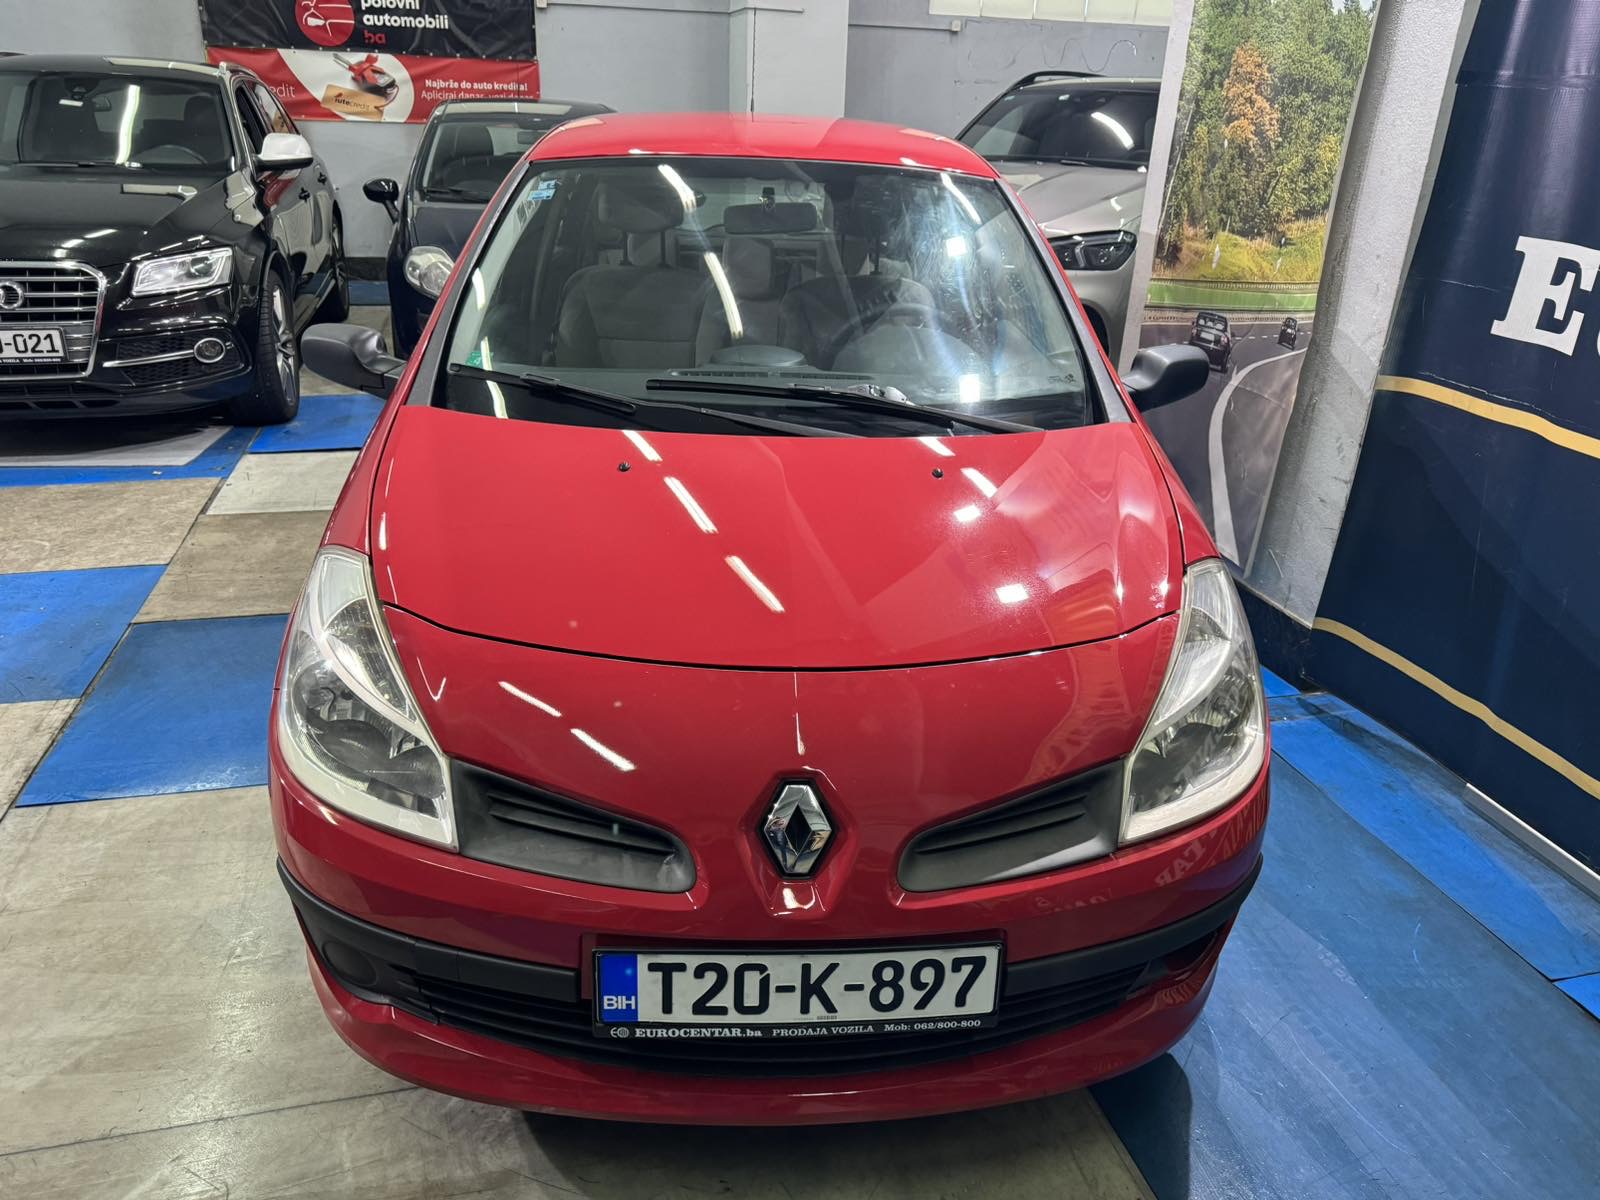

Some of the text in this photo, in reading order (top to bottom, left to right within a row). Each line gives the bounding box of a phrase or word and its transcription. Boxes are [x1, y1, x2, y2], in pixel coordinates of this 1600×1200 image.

[362, 13, 449, 29] automobili
[425, 79, 459, 90] Najbrže
[461, 80, 472, 89] do
[473, 81, 493, 91] auto
[1490, 235, 1600, 357] E
[647, 955, 988, 1017] T20-K-897
[603, 995, 637, 1010] BIH
[634, 1027, 763, 1038] EUROCENTAR.ba
[772, 1027, 828, 1037] PRODAJA
[831, 1025, 875, 1034] VOZILA
[884, 1022, 912, 1032] Mob:
[914, 1019, 982, 1030] 062/800-800
